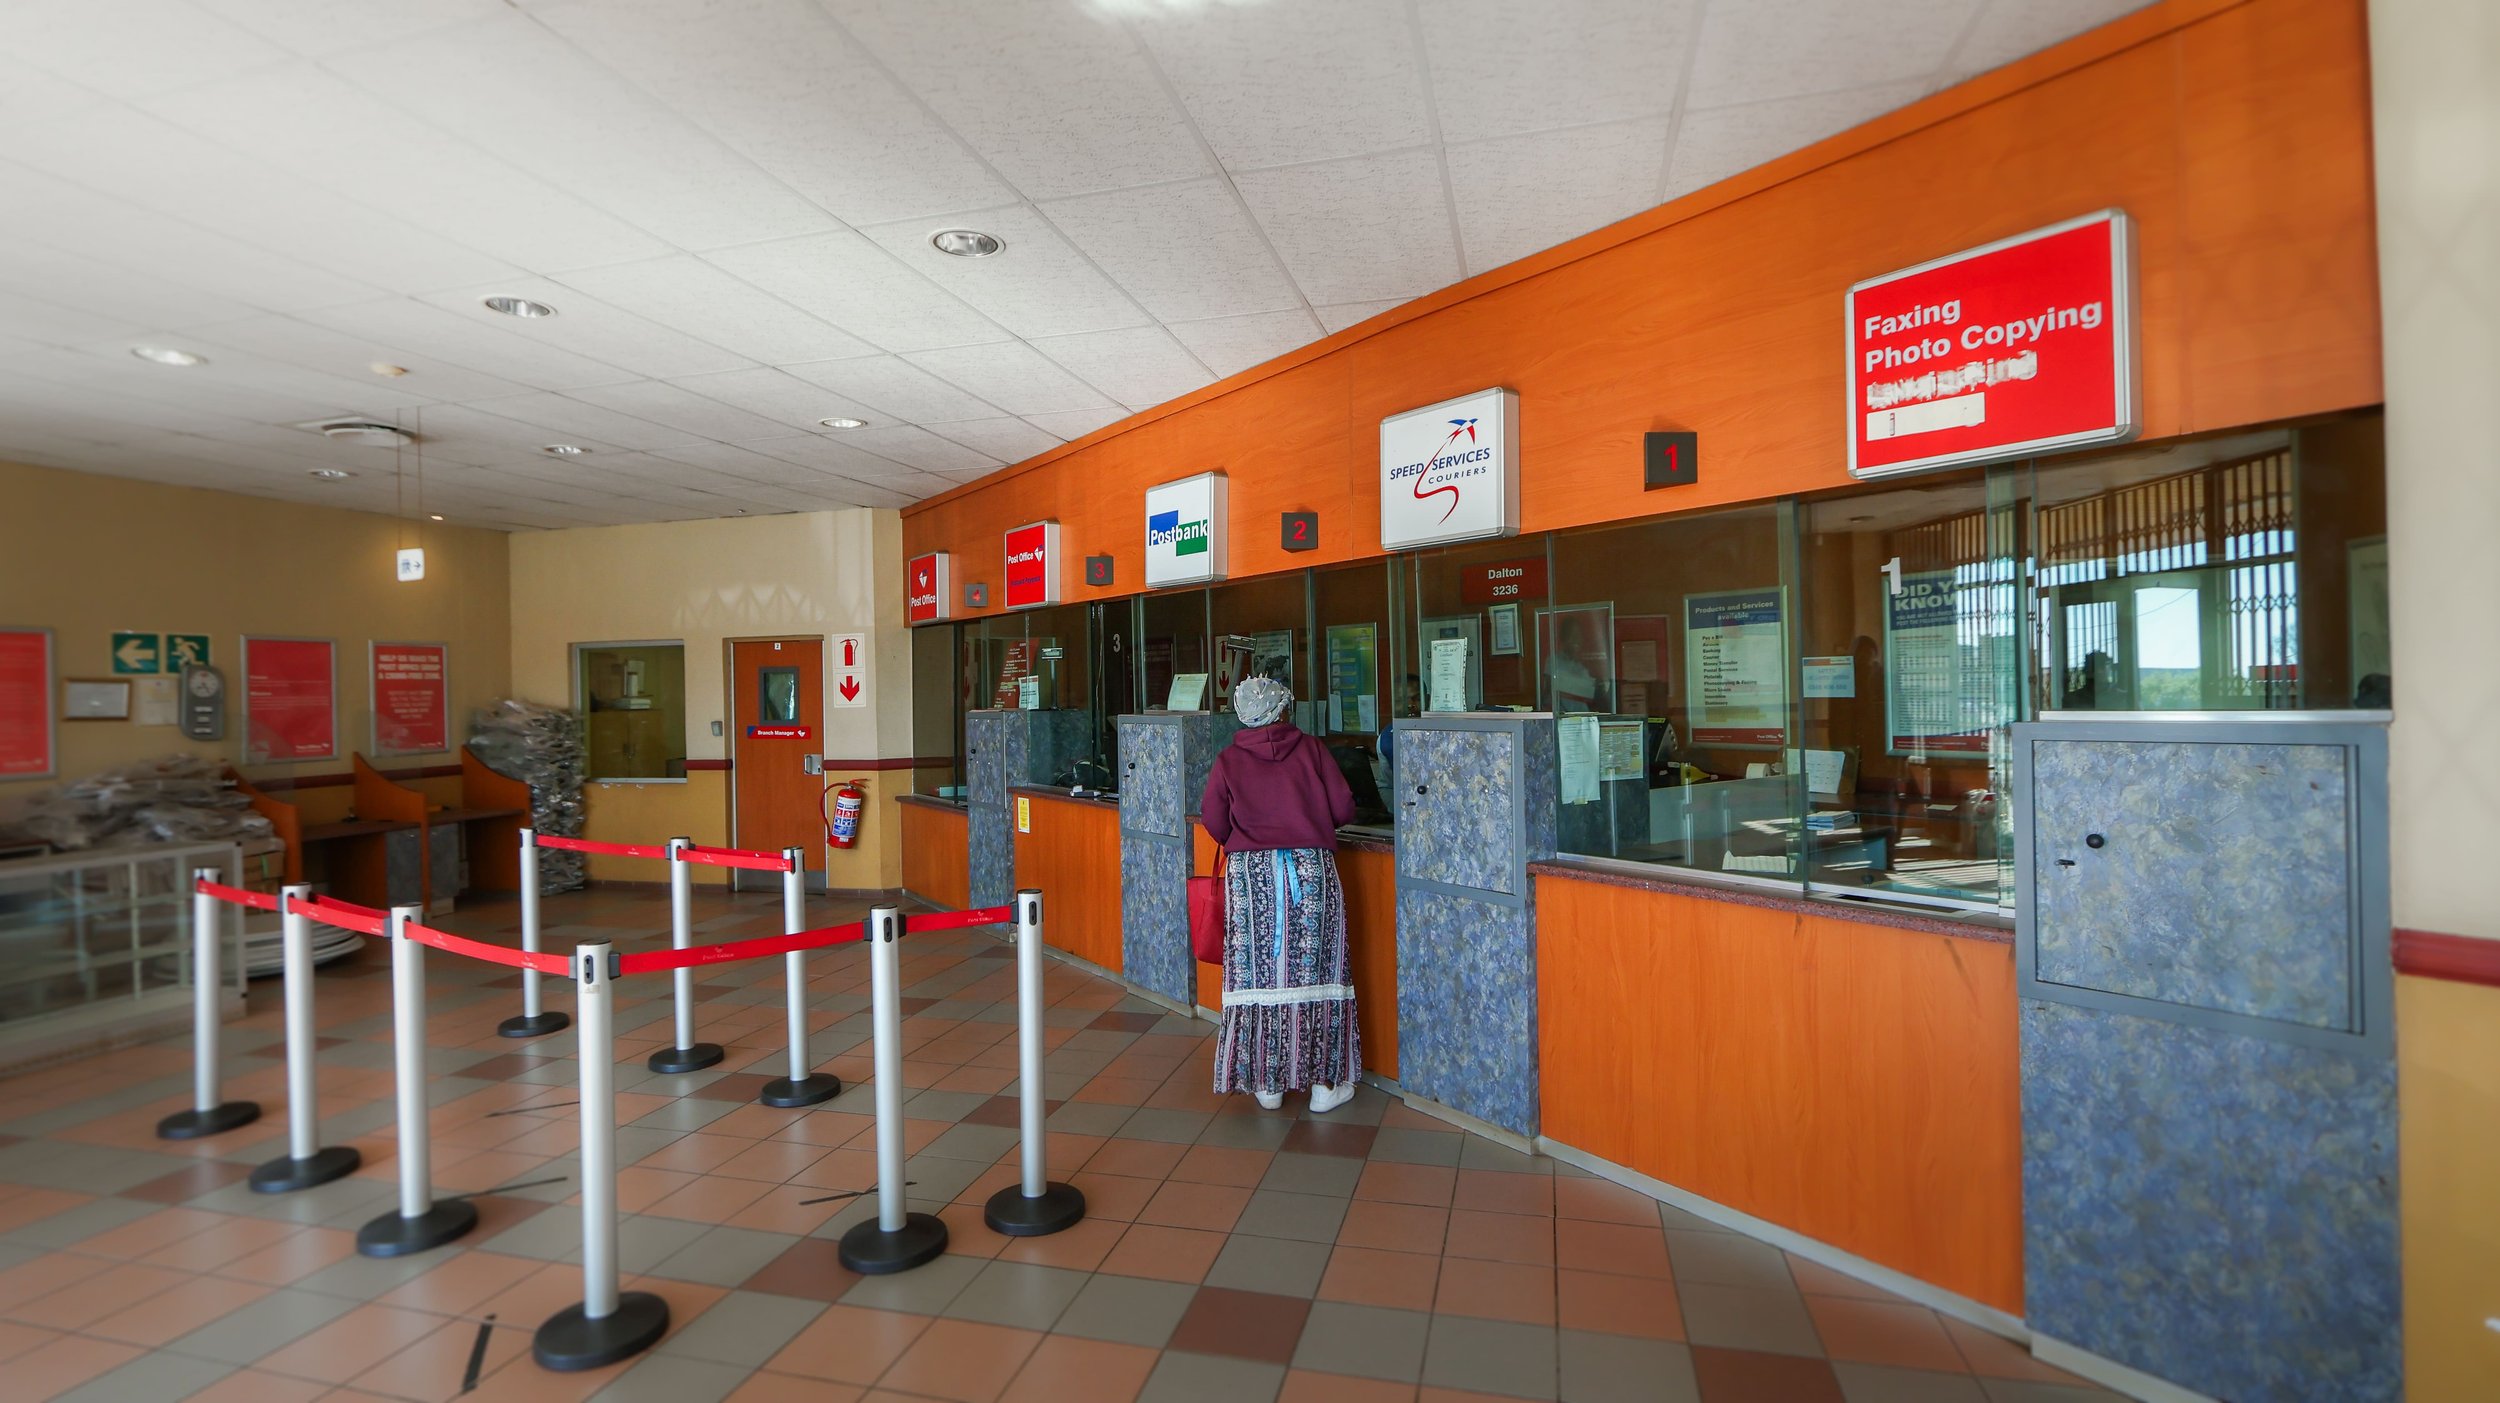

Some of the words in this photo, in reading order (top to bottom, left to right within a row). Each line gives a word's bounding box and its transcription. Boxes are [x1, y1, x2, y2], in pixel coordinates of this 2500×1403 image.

[1865, 299, 1961, 340] Faxing
[1866, 338, 1951, 373] Photo
[1961, 301, 2102, 349] Copying
[1390, 463, 1425, 480] SPEED
[1432, 447, 1491, 471] SERVICES
[1664, 443, 1678, 472] 1
[1428, 466, 1487, 484] COURIERS
[1151, 523, 1207, 546] Postbank
[1293, 520, 1307, 540] 2
[1008, 555, 1018, 564] Post
[1019, 552, 1034, 562] Office
[1094, 563, 1105, 579] 3
[1488, 568, 1523, 579] Dalton
[1881, 556, 1902, 595] 1
[1492, 584, 1519, 596] 3236
[911, 596, 921, 607] Post
[921, 594, 936, 604] Office
[1695, 605, 1725, 614] Products
[1727, 603, 1740, 611] and
[1742, 601, 1774, 610] Services
[1718, 611, 1750, 621] available
[1113, 633, 1121, 653] 3
[774, 729, 795, 737] Manager
